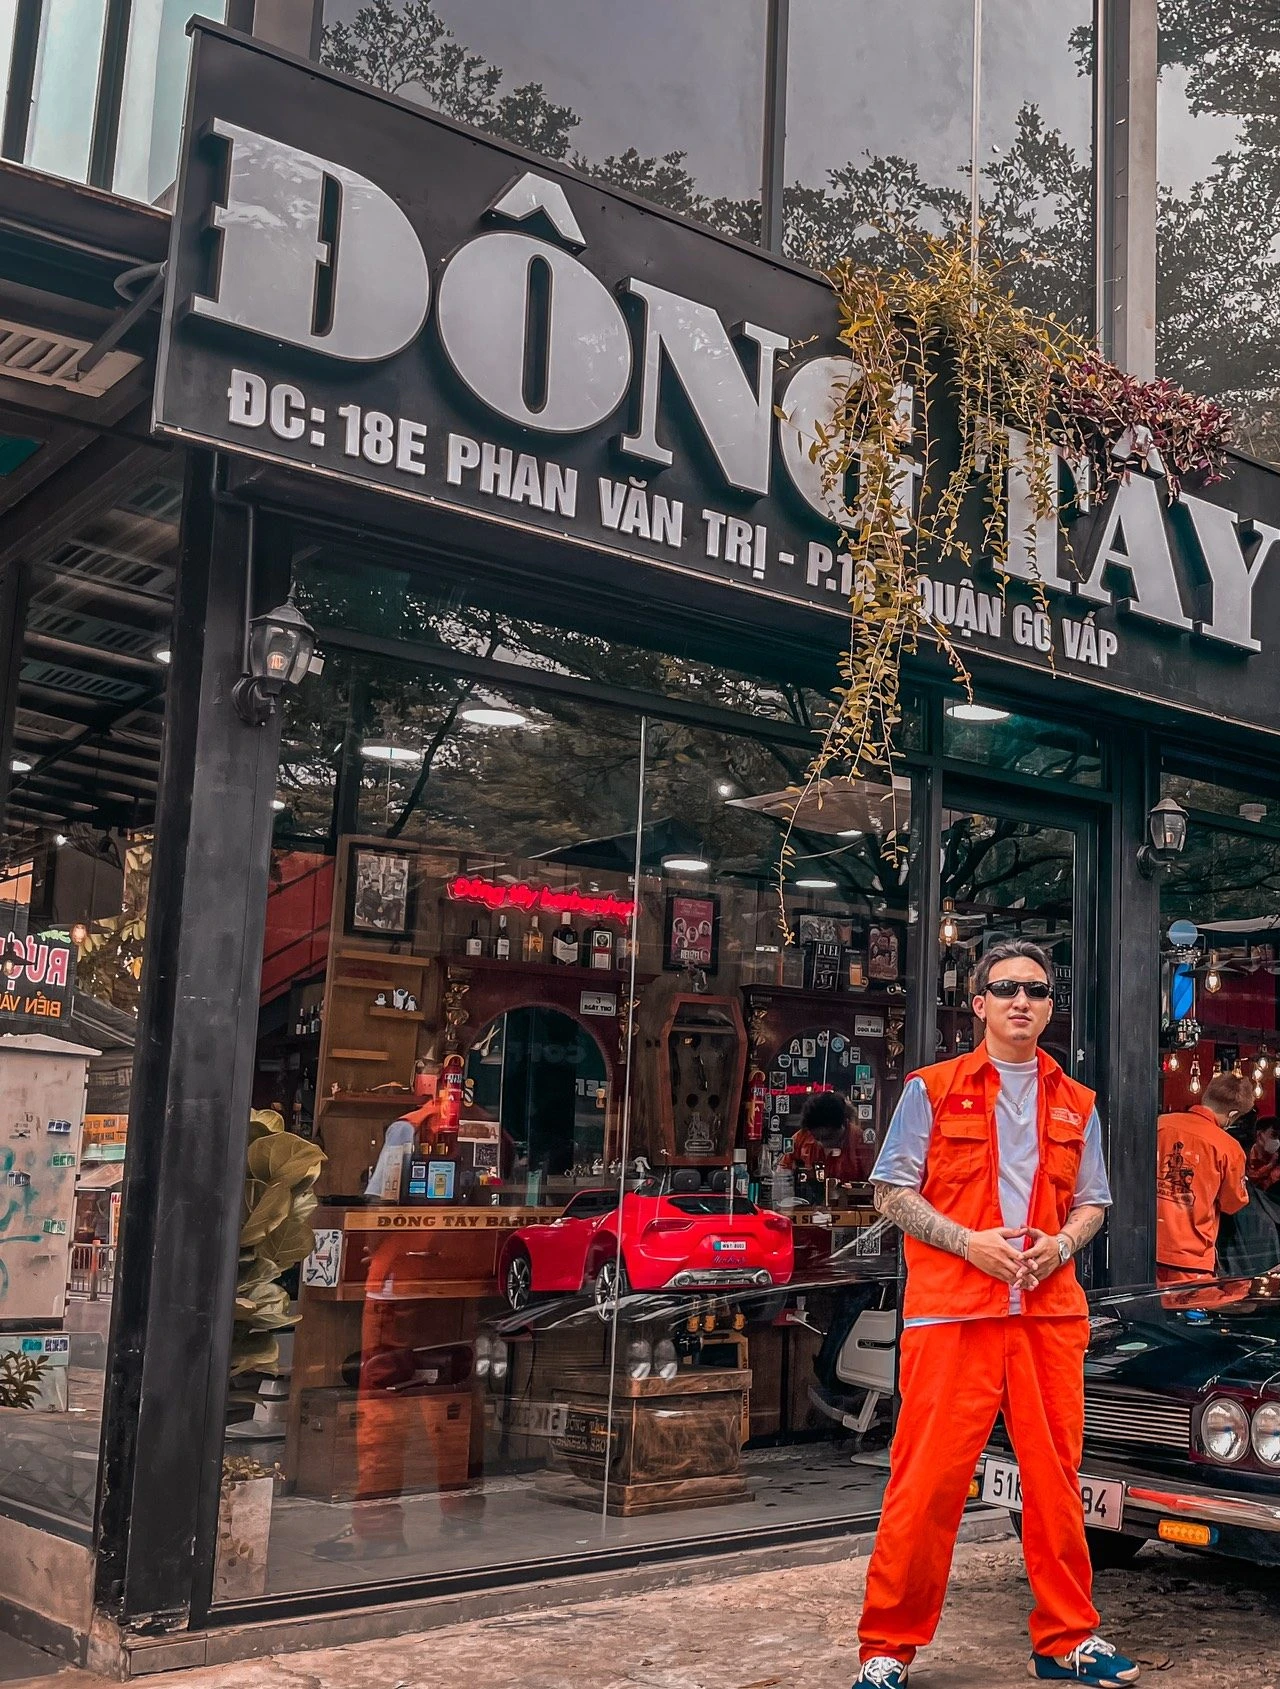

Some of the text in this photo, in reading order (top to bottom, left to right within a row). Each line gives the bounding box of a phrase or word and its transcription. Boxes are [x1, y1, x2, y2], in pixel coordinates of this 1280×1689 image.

[191, 116, 924, 541] ĐÔNG
[227, 368, 326, 446] ĐC:
[338, 404, 427, 475] 18E
[446, 432, 578, 518] PHAN
[598, 476, 684, 548] VĂN
[701, 508, 767, 580] TRỊ
[916, 575, 1001, 639] QUẬN
[1012, 602, 1051, 652] GÒ
[1062, 610, 1117, 669] VẤP
[817, 943, 839, 957] FUEL
[486, 1216, 559, 1227] BARBE
